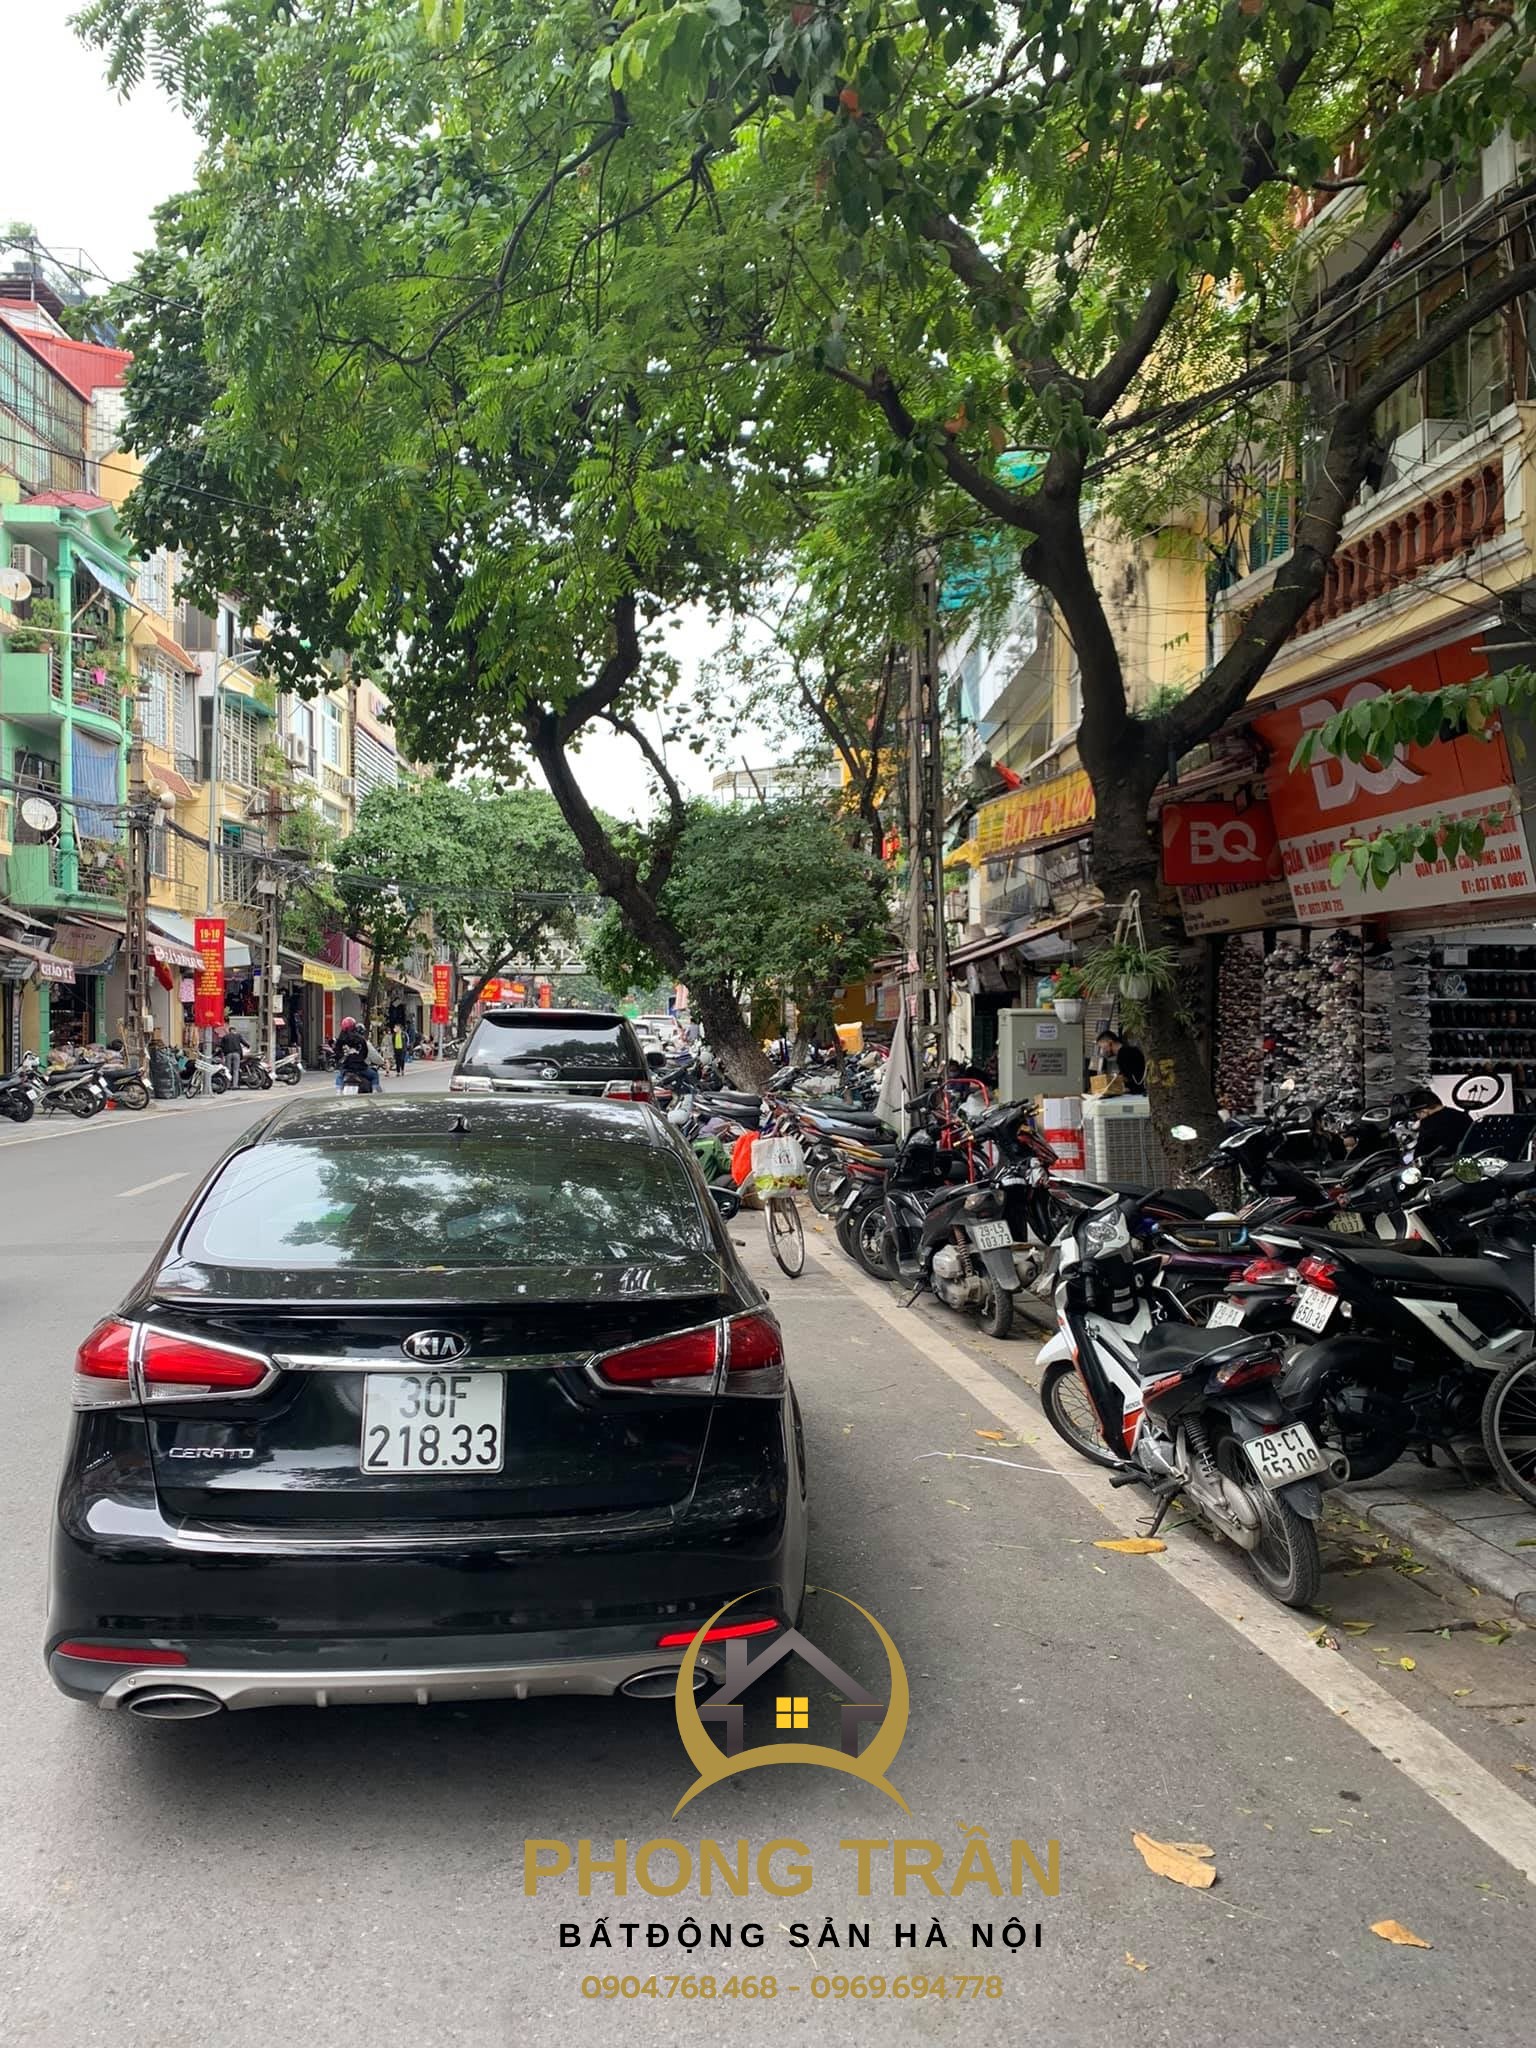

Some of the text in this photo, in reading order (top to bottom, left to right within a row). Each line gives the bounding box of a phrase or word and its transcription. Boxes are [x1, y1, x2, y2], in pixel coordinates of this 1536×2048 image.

[1189, 820, 1262, 865] BQ
[414, 1336, 457, 1356] KIA
[400, 1376, 471, 1418] 30F
[169, 1447, 254, 1459] CERATO
[368, 1424, 497, 1467] 218.33
[1255, 1428, 1304, 1462] 29-C1
[1262, 1448, 1317, 1478] 153.09
